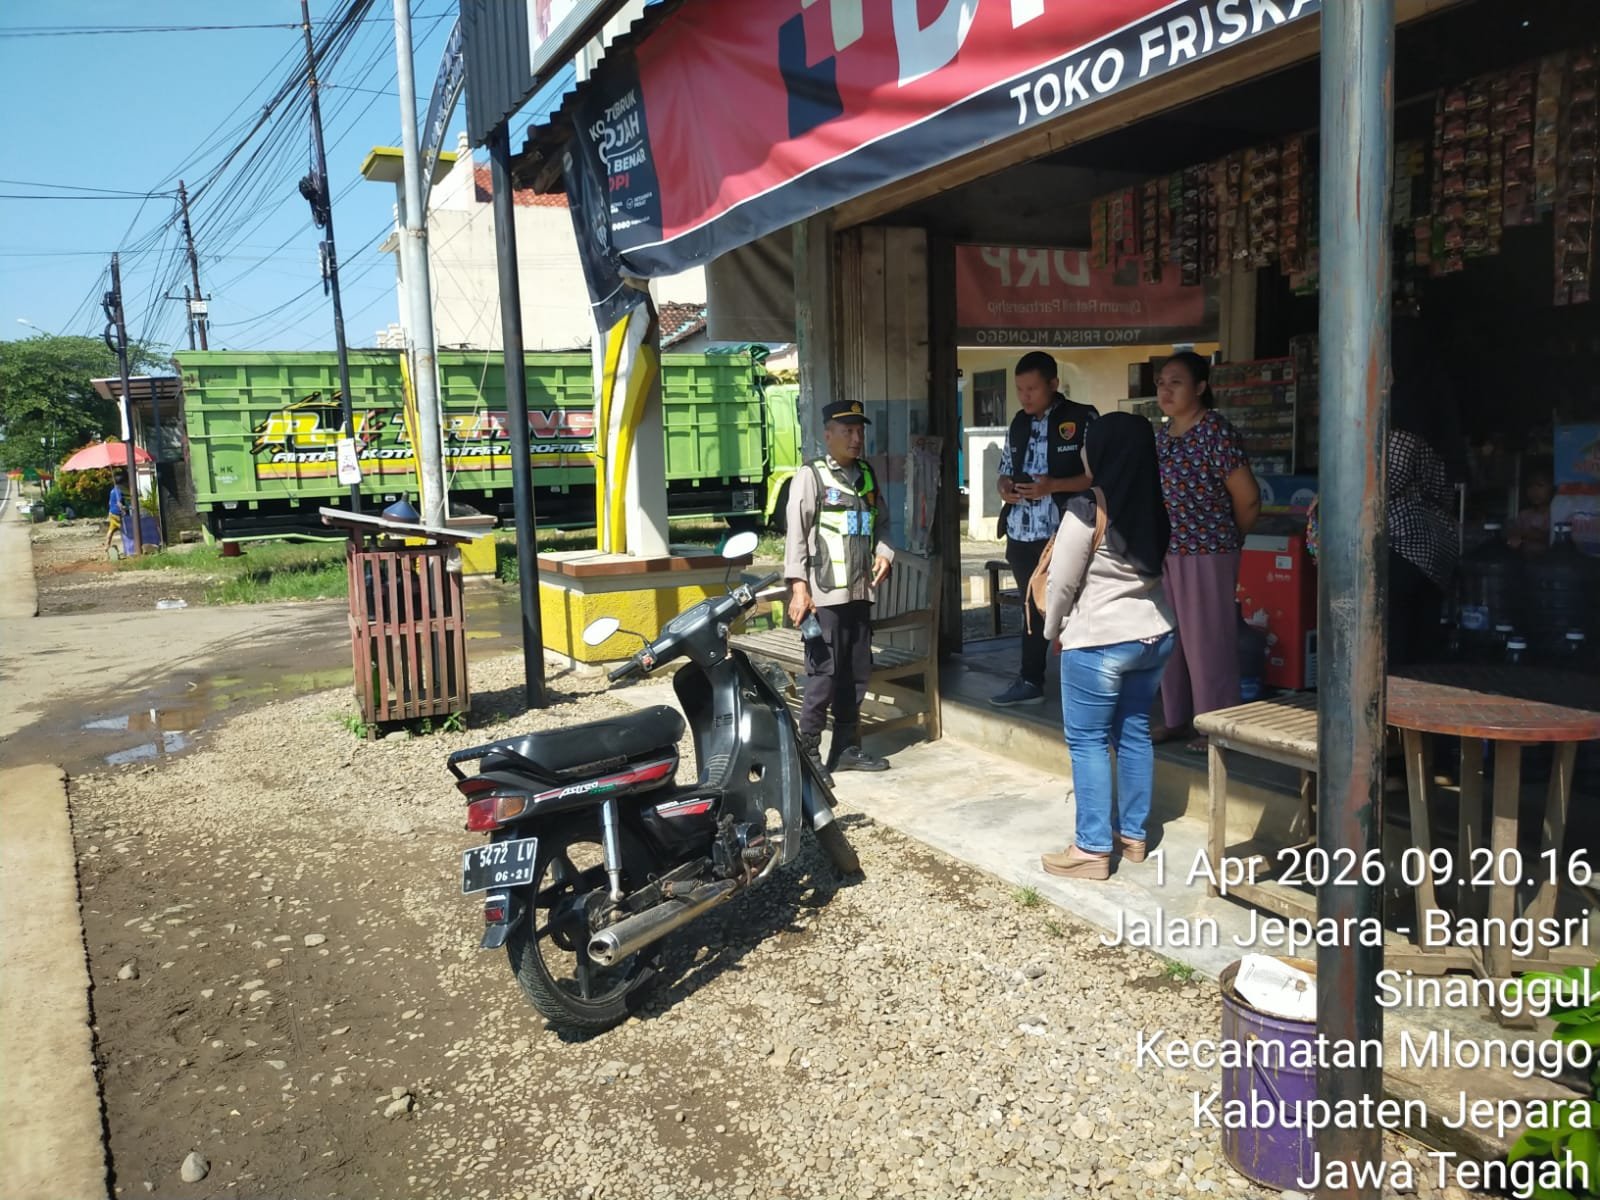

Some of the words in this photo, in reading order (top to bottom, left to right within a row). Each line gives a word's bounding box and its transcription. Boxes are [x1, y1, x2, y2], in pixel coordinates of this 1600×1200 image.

[1010, 48, 1125, 125] TOKO
[464, 853, 471, 871] K
[517, 842, 534, 862] LV
